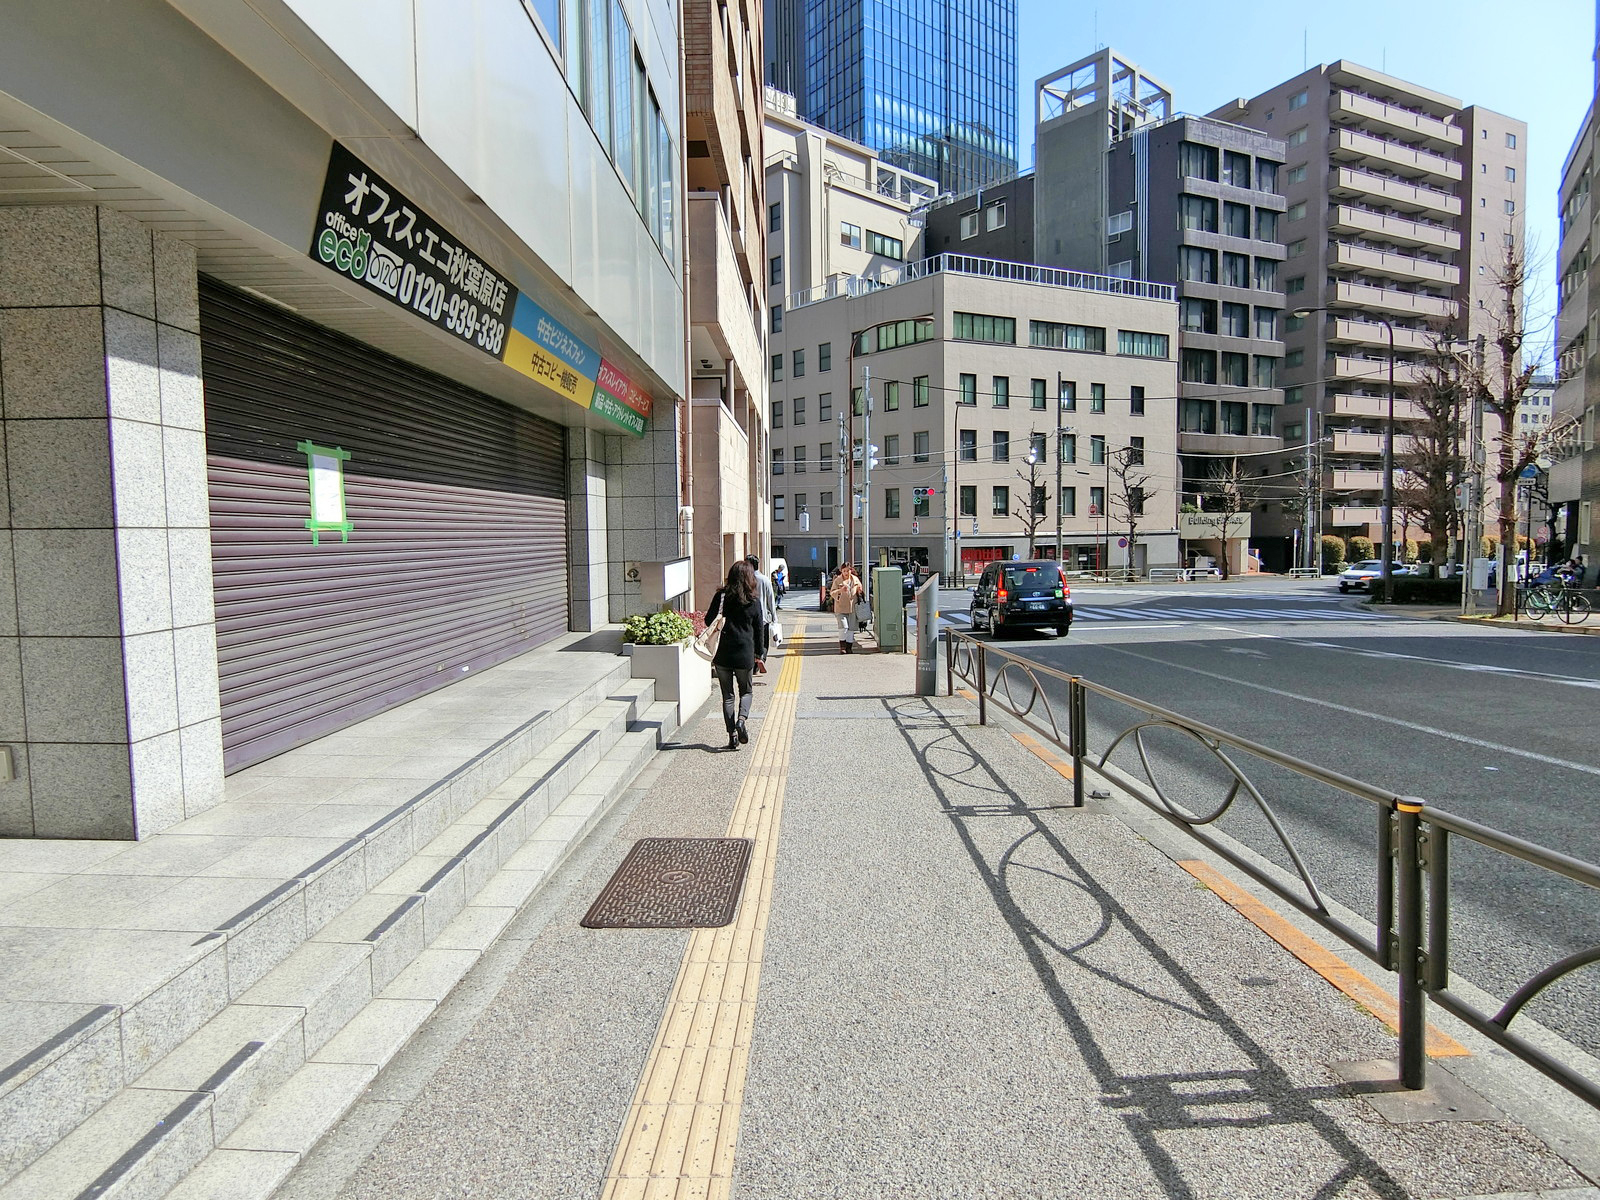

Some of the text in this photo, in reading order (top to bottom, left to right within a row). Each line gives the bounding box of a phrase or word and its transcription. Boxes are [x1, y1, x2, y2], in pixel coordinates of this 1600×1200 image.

[325, 211, 358, 242] office
[344, 172, 509, 316] オフィス・エコ秋葉原店
[318, 228, 368, 280] eco
[399, 262, 505, 355] 0120-939-338
[536, 316, 586, 365] 中古ビジネスフォン
[531, 351, 579, 395] 中古コピー機販売
